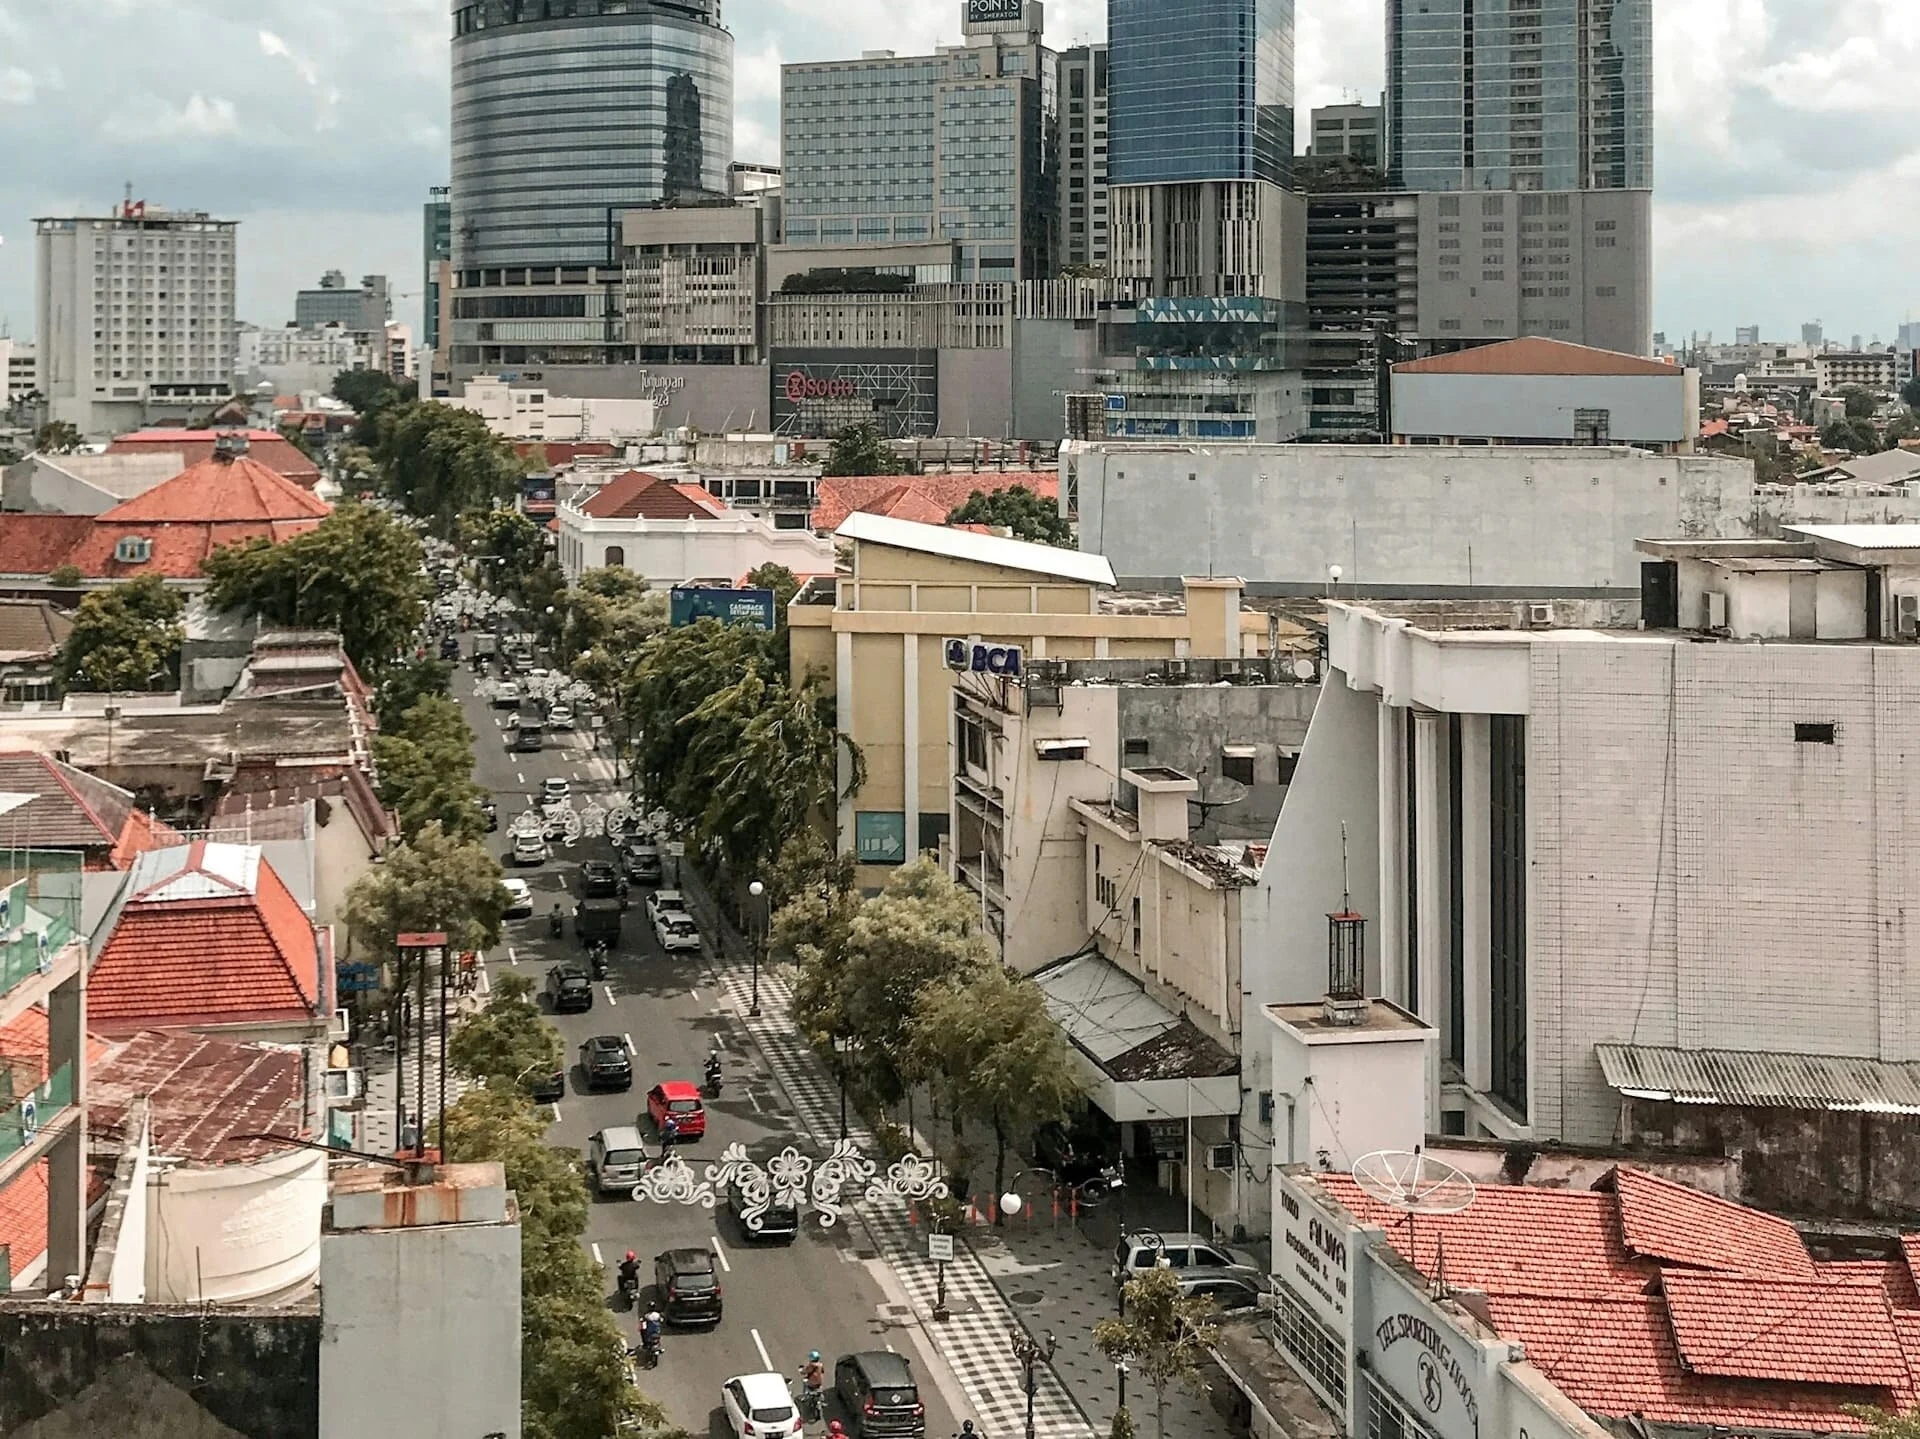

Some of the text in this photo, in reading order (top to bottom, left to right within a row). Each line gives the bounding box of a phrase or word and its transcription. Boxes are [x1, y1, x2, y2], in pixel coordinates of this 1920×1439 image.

[970, 0, 1019, 12] POINTS
[983, 11, 1019, 19] SHERATON
[729, 603, 764, 611] CASHBACK
[971, 645, 1019, 676] BCA
[1280, 1188, 1299, 1220] TOKO
[1376, 1315, 1399, 1352] THE
